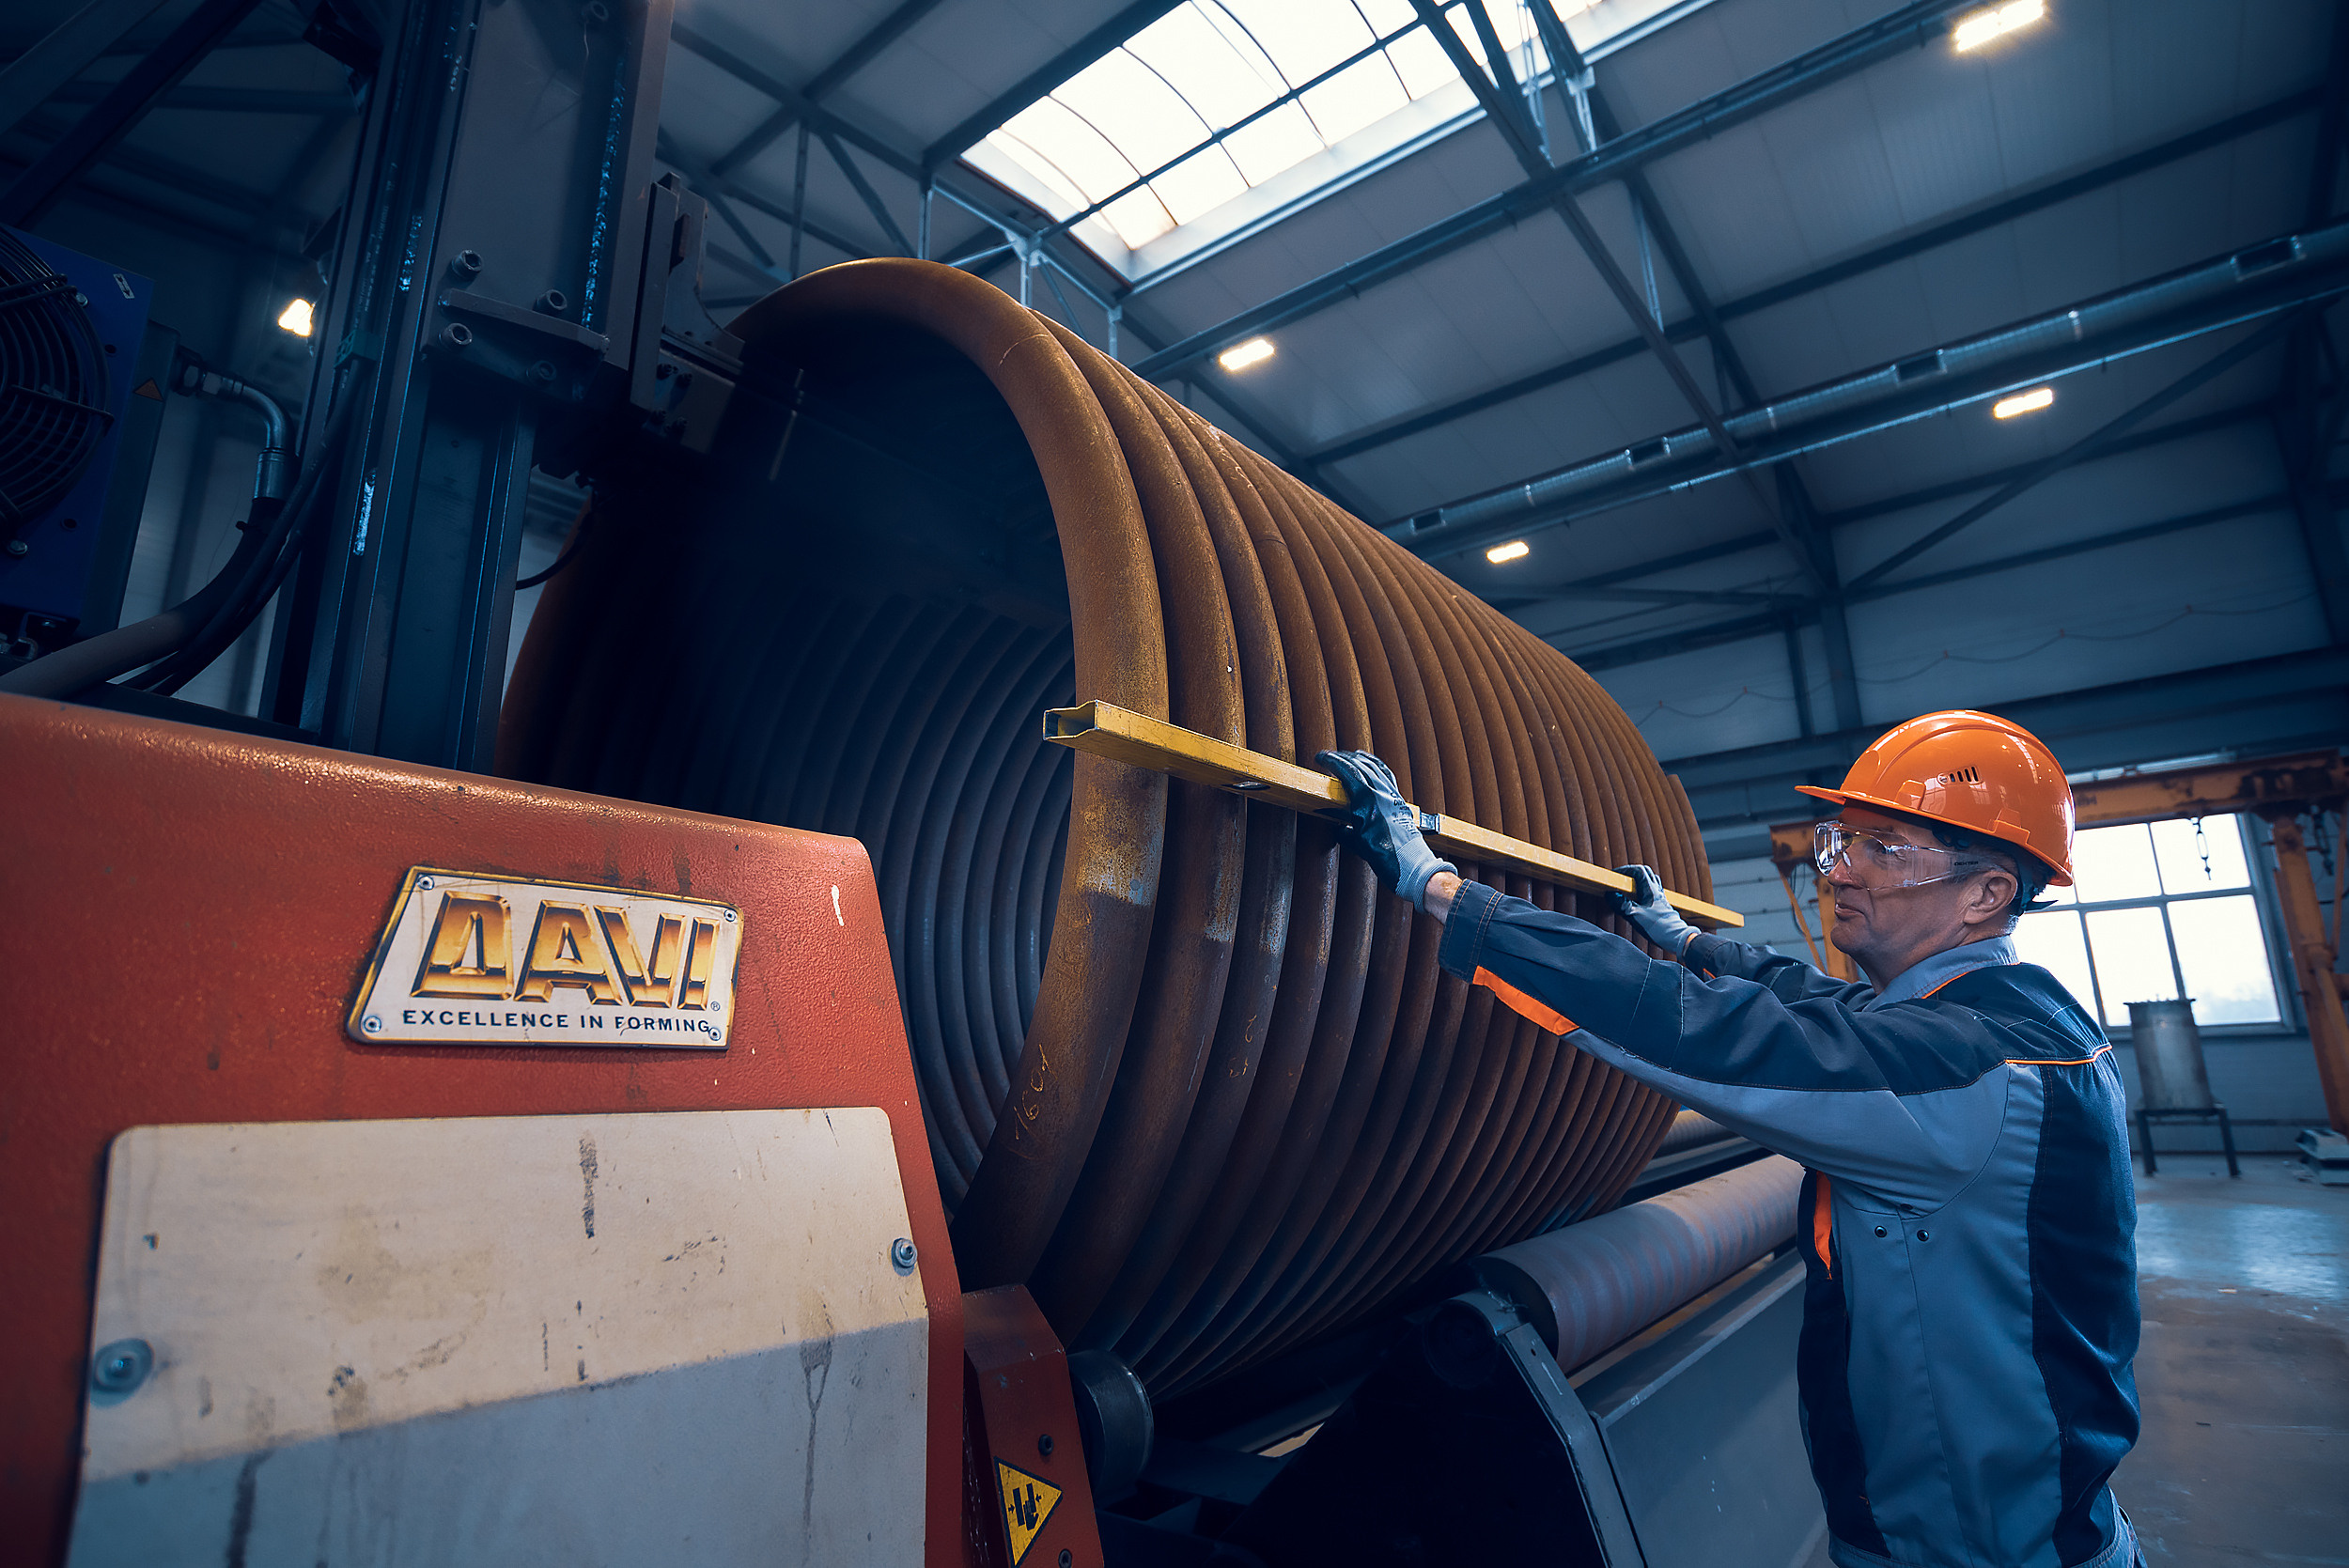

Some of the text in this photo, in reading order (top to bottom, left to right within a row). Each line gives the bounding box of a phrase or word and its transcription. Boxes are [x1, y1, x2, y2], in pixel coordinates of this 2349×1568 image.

[410, 890, 721, 1011] DAVI
[403, 1010, 711, 1032] EXCELLENCE IN FORMING
